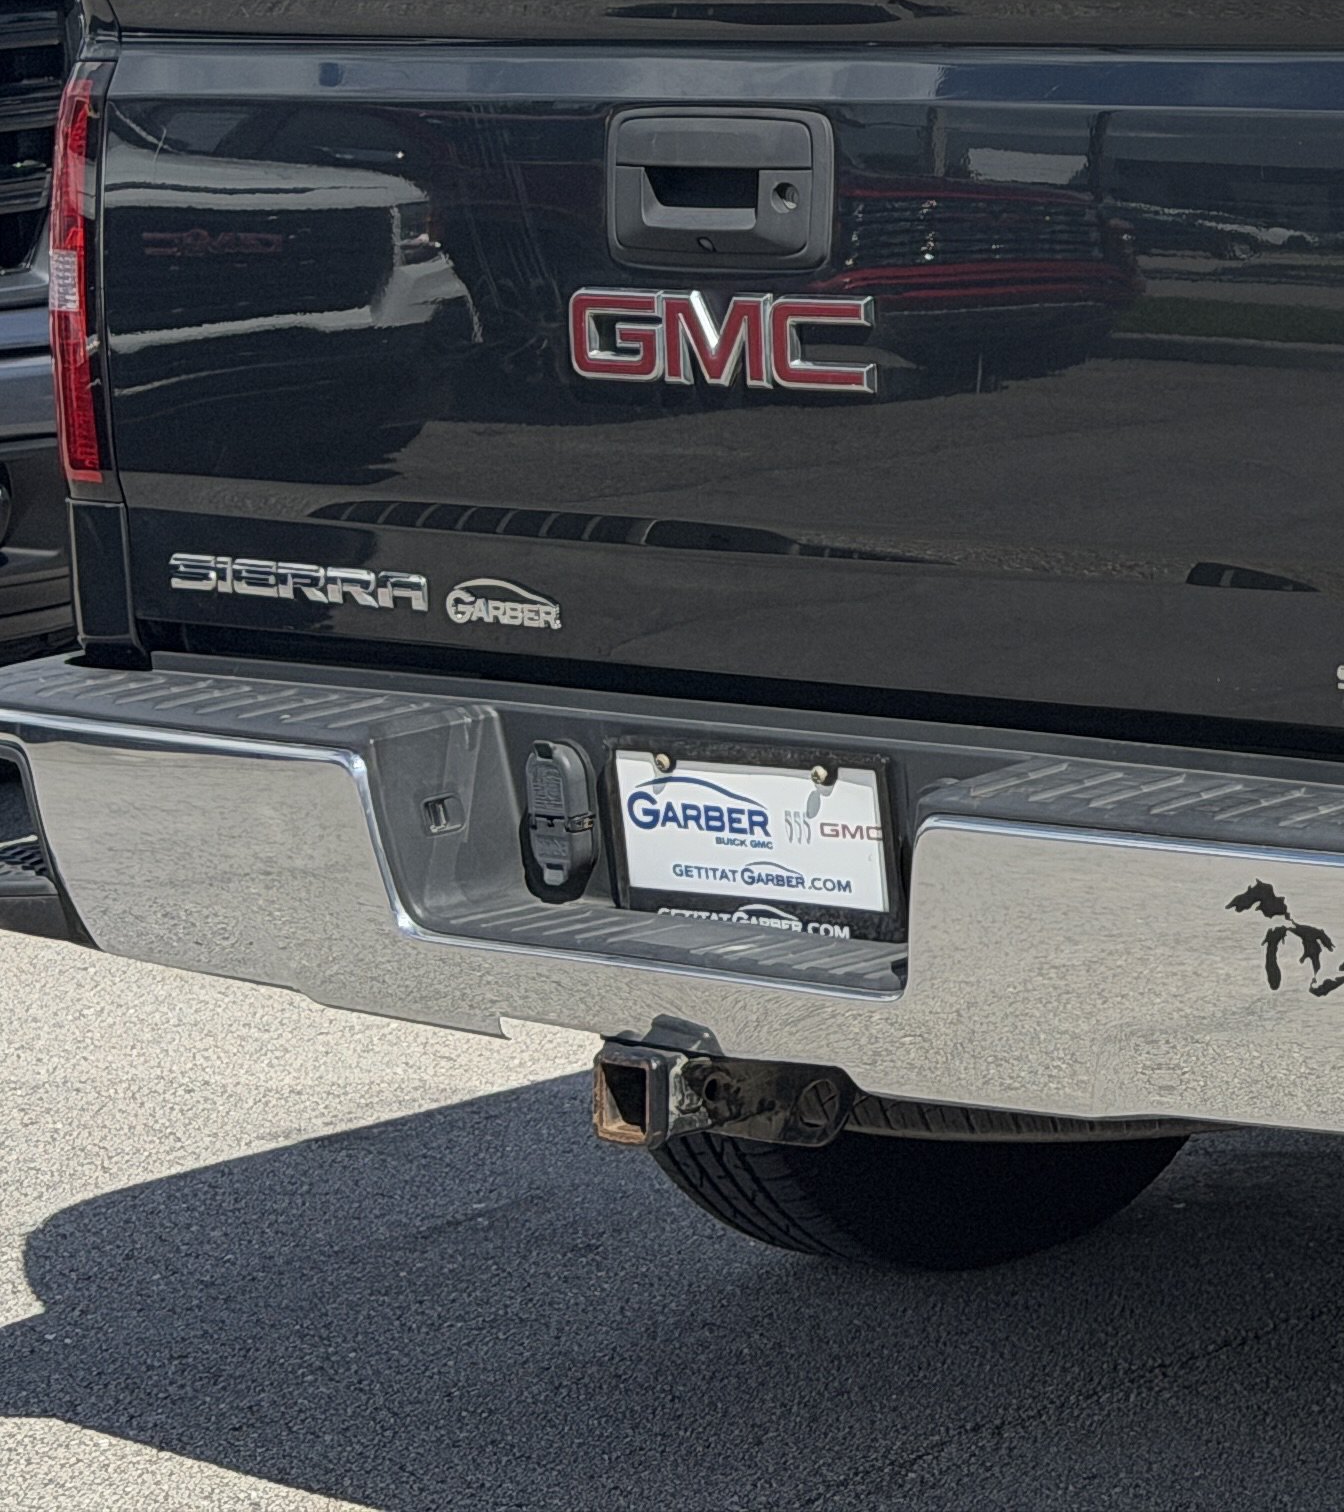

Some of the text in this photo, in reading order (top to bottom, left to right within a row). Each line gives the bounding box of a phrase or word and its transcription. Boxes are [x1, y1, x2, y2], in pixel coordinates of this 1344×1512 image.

[570, 287, 877, 393] GMC
[169, 553, 429, 612] SIERRA
[445, 589, 562, 630] GARBER
[627, 790, 772, 838] GARBER
[820, 822, 884, 842] GMC
[715, 836, 774, 850] BUICK GMC
